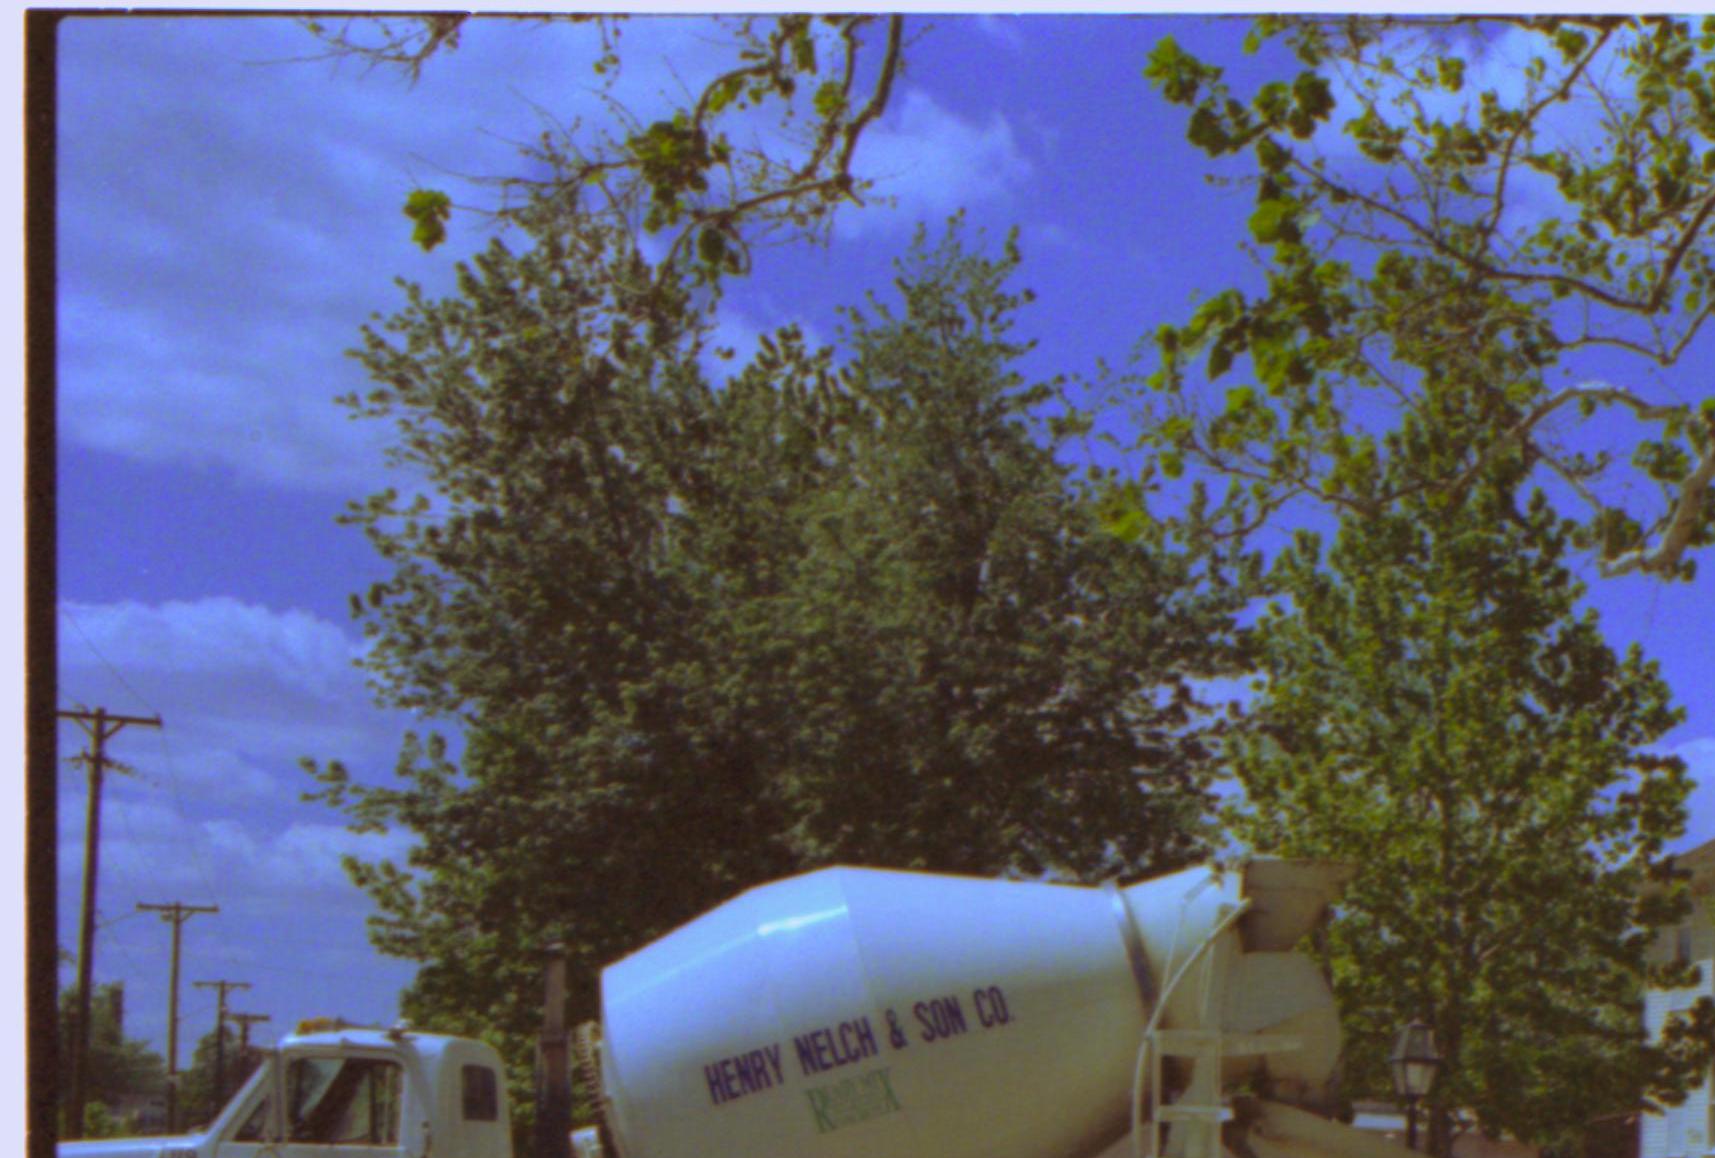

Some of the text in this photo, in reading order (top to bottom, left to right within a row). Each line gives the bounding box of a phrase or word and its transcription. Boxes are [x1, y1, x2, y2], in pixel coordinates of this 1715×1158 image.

[704, 1043, 784, 1105] HENRY
[794, 1017, 878, 1076] NELCH
[885, 1008, 908, 1050] &
[913, 995, 968, 1042] SON
[973, 986, 1015, 1028] CO.
